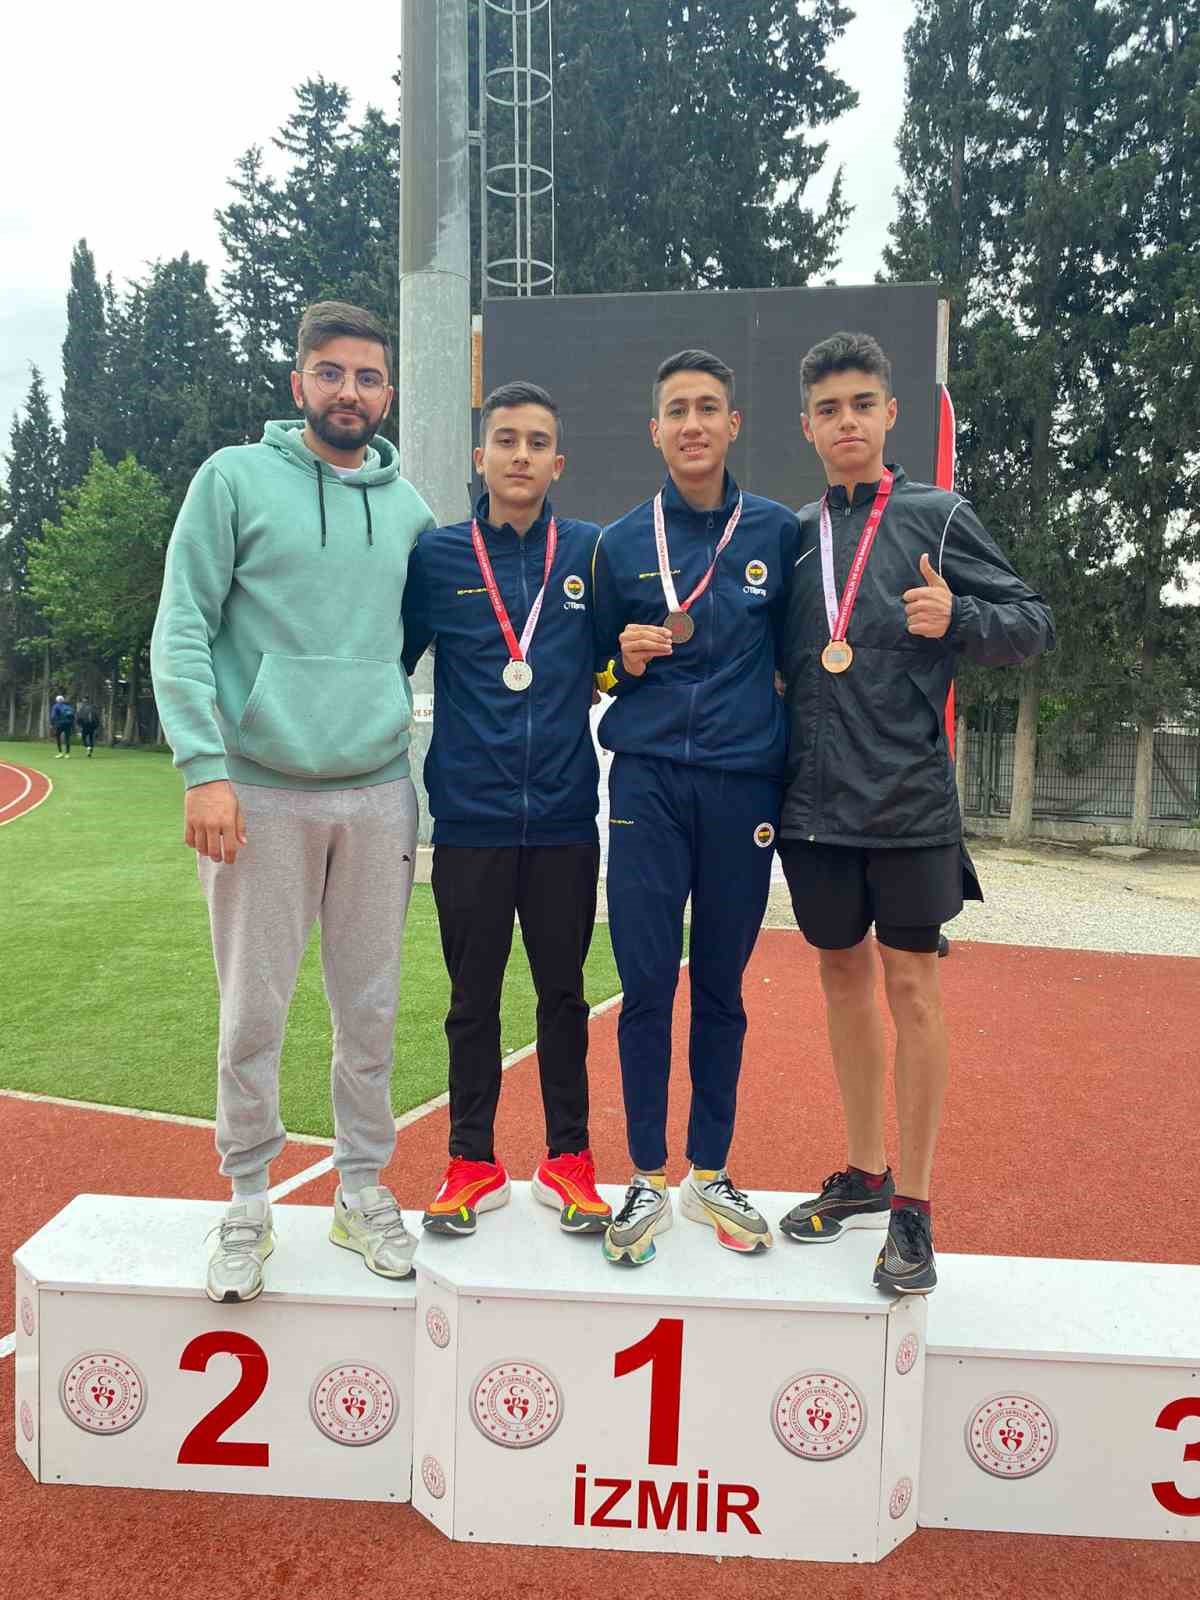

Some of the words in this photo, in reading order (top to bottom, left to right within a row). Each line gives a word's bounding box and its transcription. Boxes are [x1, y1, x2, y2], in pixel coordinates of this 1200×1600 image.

[424, 709, 432, 718] SP
[177, 1331, 270, 1467] 2
[614, 1318, 684, 1466] 1
[574, 1464, 762, 1535] İZMİR
[1151, 1396, 1200, 1516] 3
